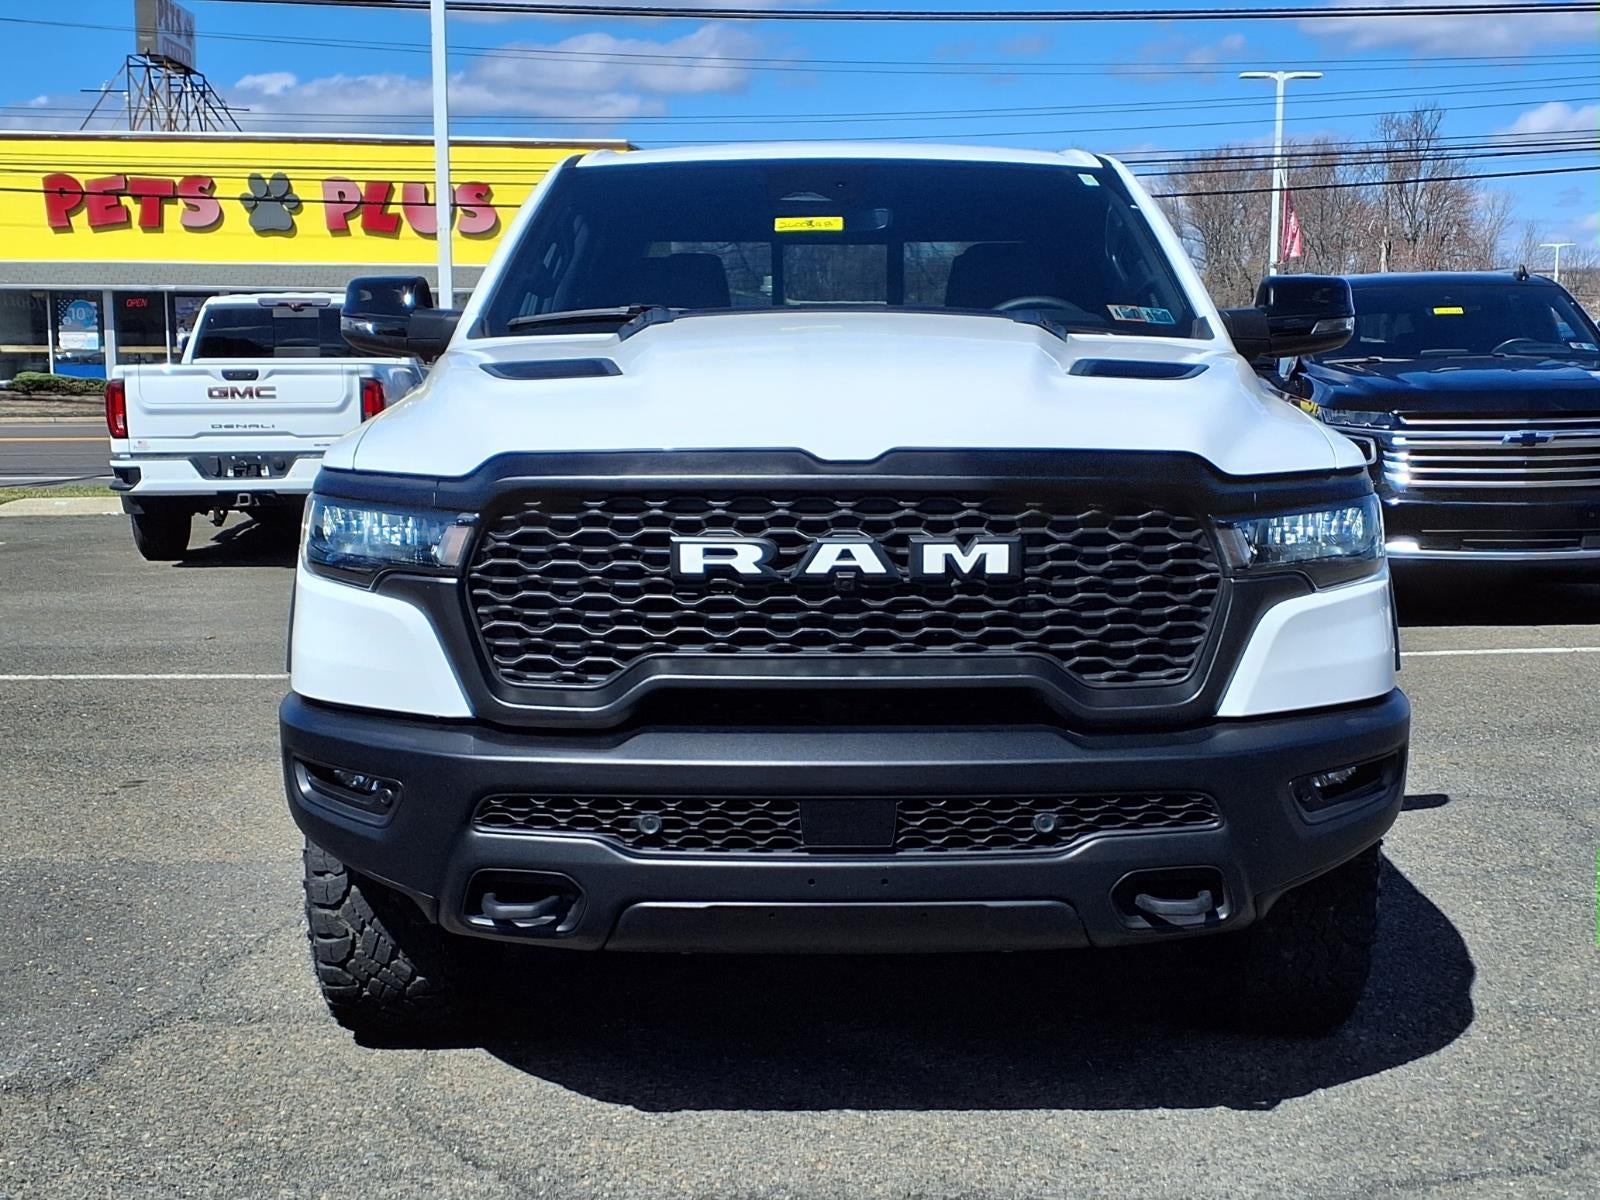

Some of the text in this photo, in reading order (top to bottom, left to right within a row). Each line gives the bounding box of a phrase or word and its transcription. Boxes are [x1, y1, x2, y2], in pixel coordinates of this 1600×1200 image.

[42, 173, 500, 239] PETS PLUS
[126, 298, 148, 307] OPEN
[208, 386, 276, 399] GMC
[674, 539, 1015, 577] RAM
